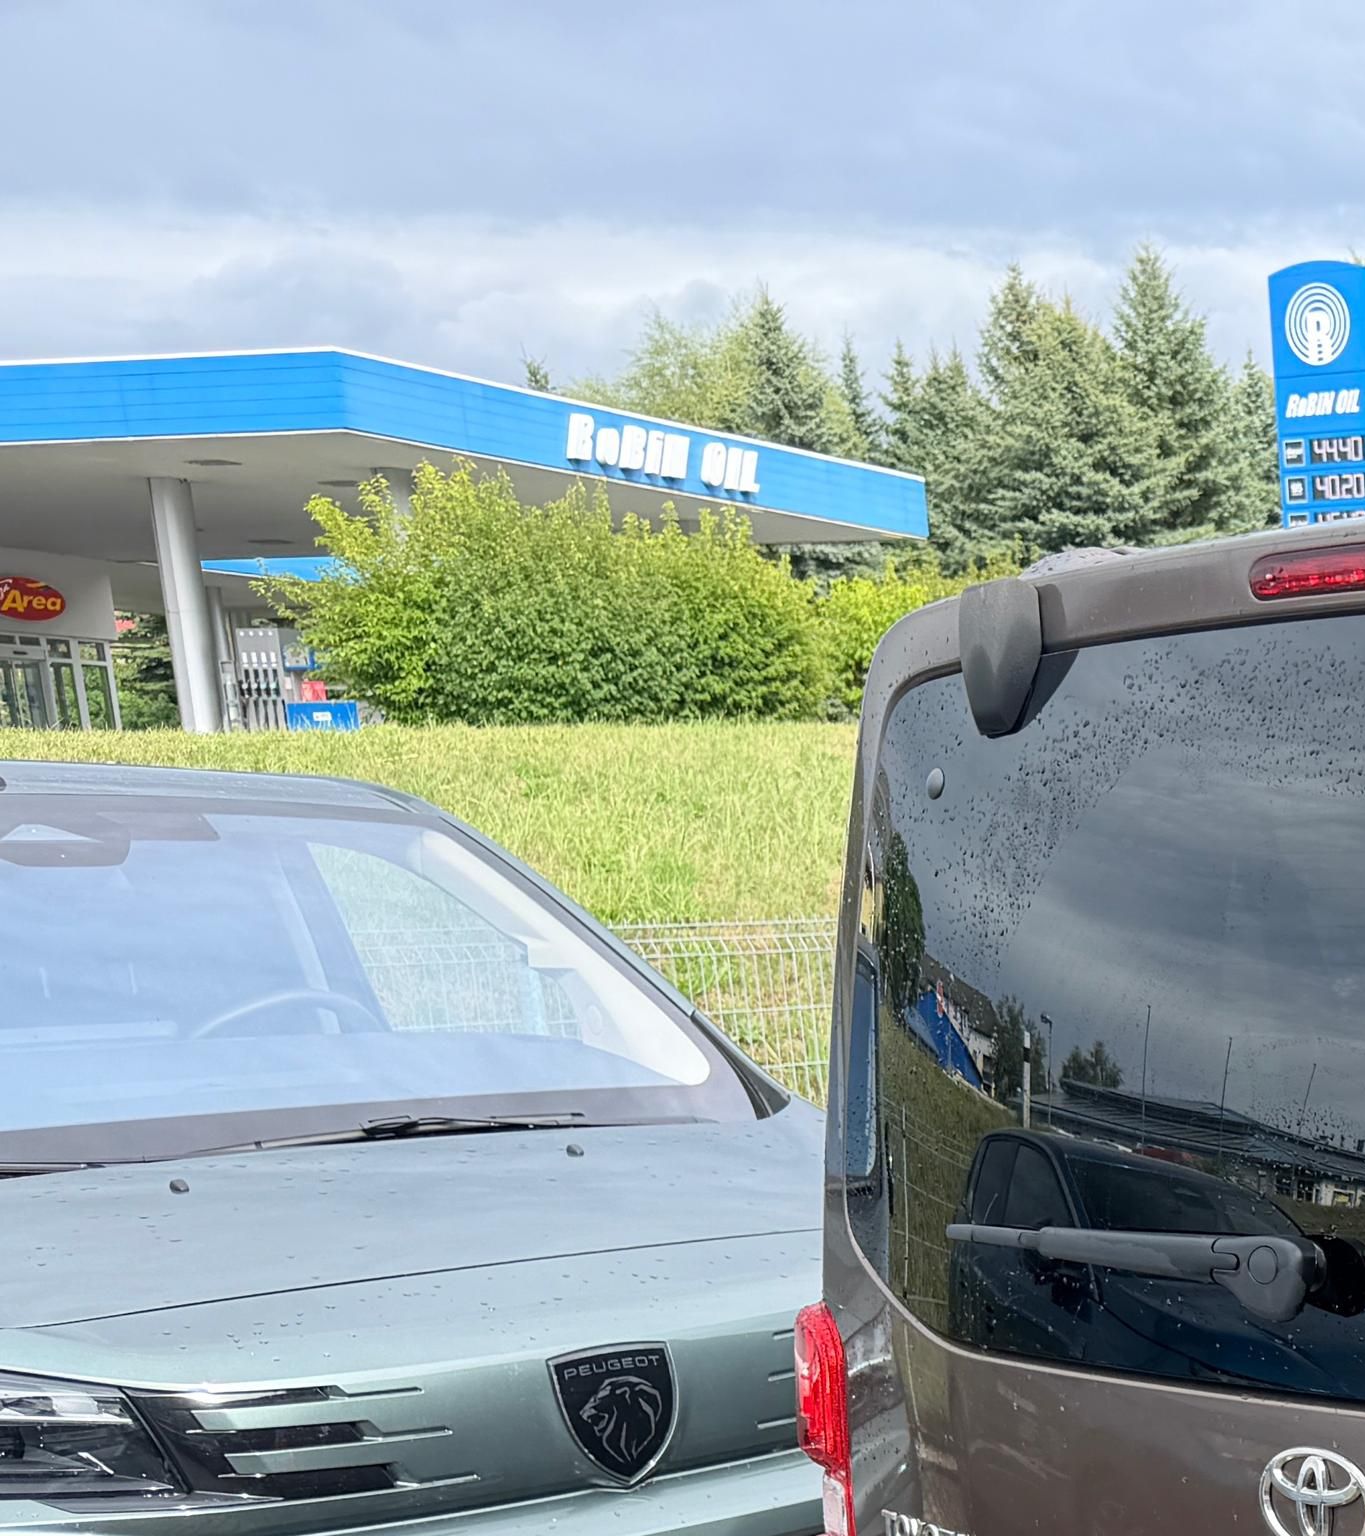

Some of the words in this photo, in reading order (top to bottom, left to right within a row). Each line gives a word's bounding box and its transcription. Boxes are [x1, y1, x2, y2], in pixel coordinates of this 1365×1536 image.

[1335, 388, 1361, 415] OIL
[700, 441, 760, 494] OIL
[0, 589, 62, 613] Area
[563, 1355, 660, 1381] PEUGEOT
